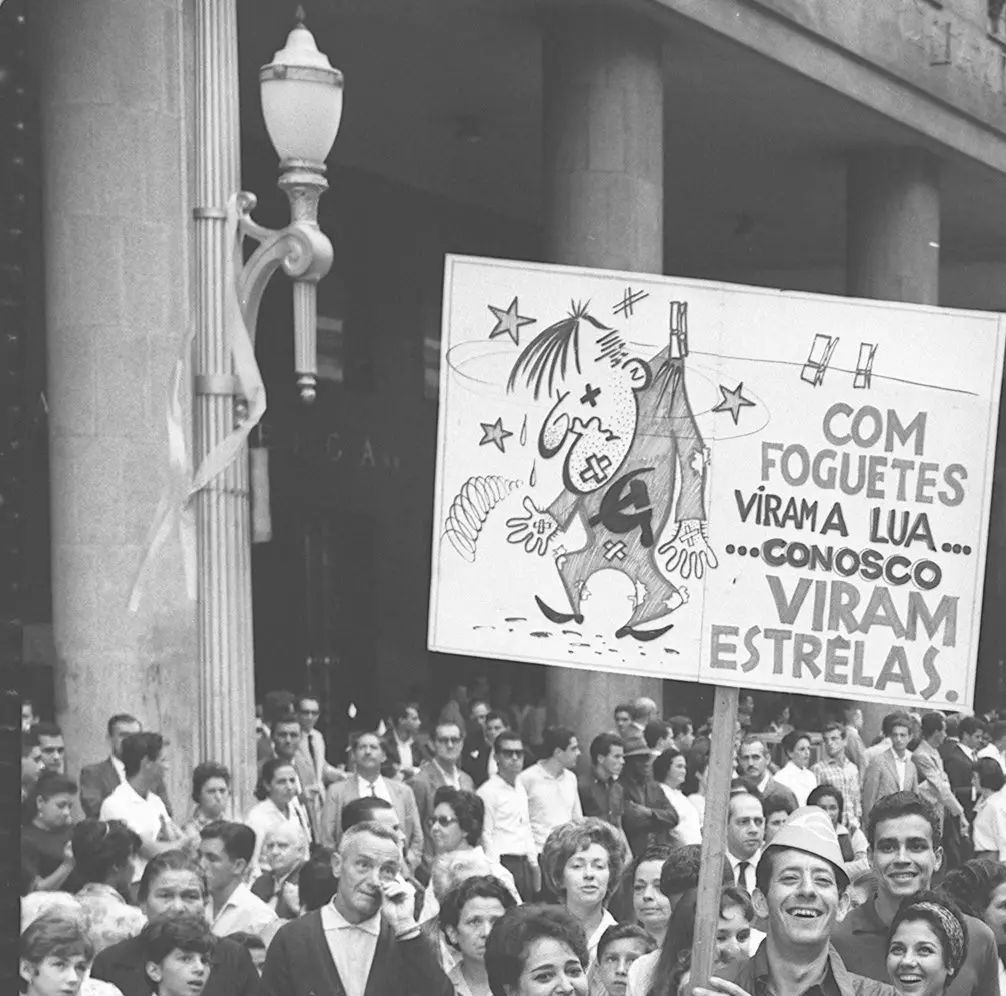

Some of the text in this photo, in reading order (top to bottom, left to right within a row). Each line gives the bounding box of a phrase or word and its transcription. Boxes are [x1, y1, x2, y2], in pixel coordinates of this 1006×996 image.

[822, 402, 927, 456] COM
[761, 441, 968, 507] FOGUETES
[765, 574, 960, 648] VIRAM
